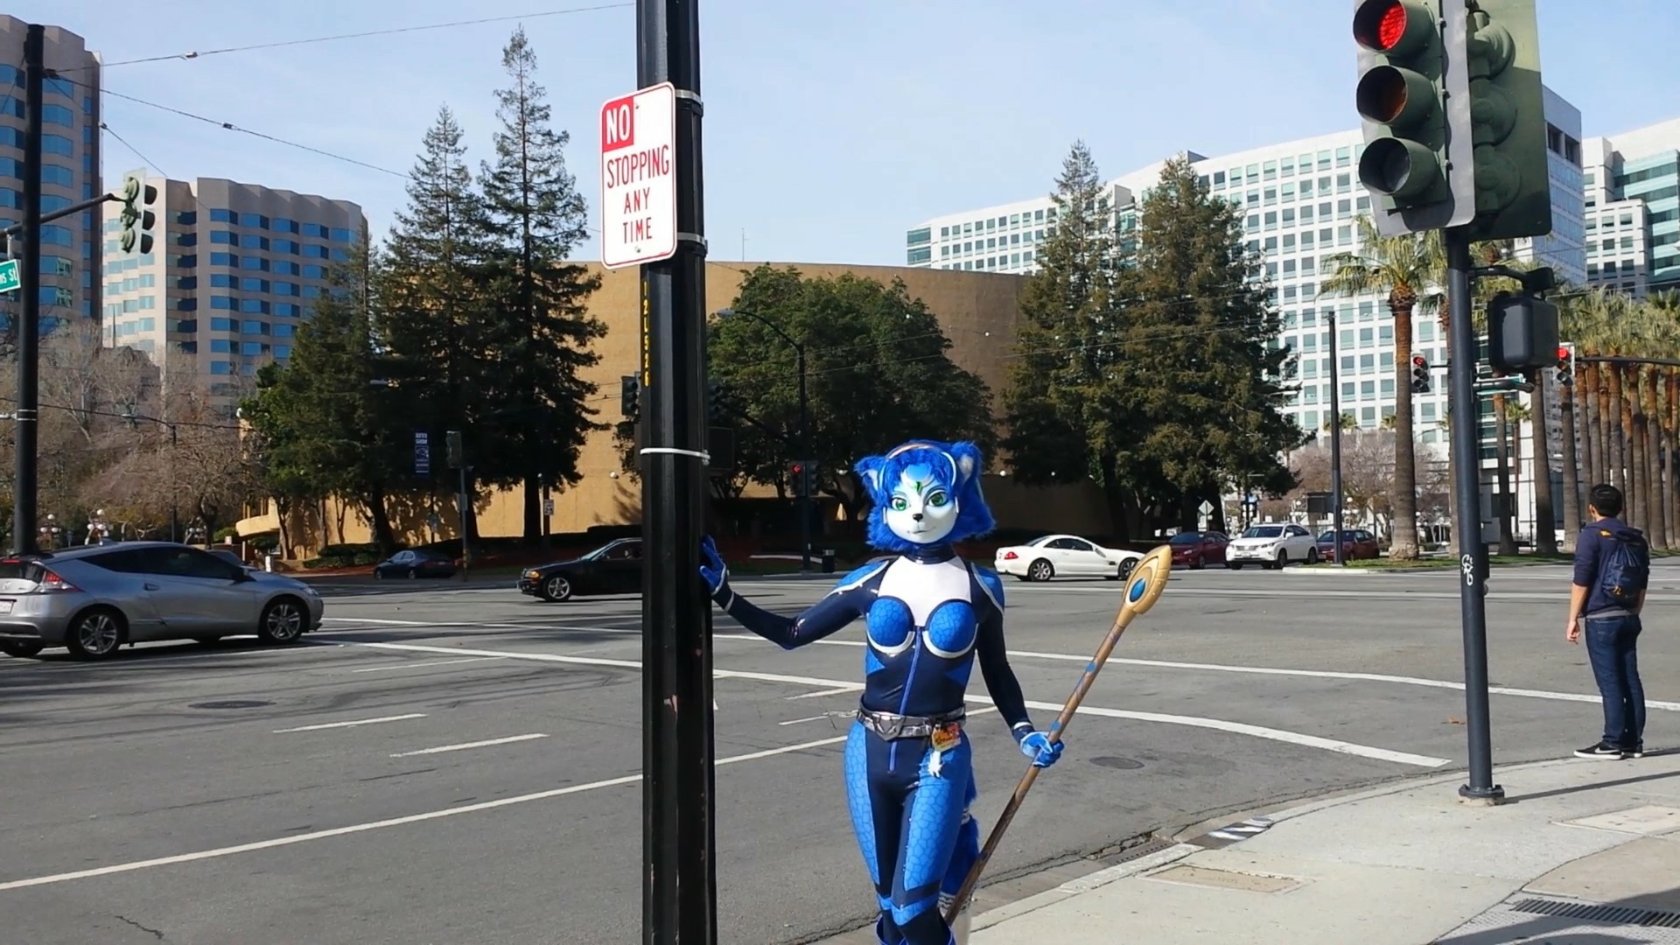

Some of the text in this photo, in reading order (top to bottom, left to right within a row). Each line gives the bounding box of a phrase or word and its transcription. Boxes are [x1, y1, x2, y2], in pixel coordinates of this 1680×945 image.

[606, 104, 631, 145] NO
[607, 145, 669, 189] STOPPING
[623, 187, 650, 215] ANY
[623, 217, 653, 244] TIME
